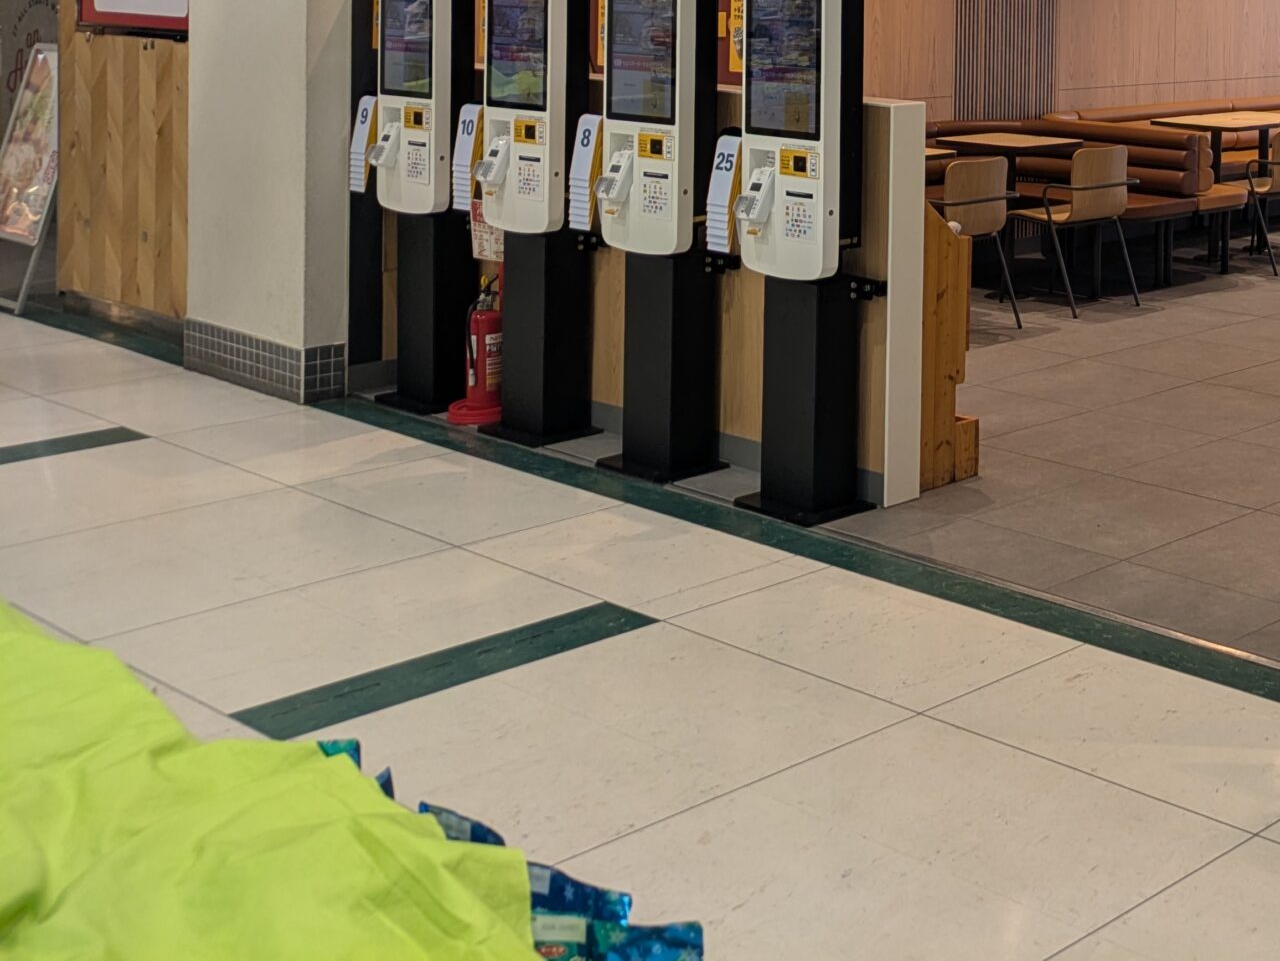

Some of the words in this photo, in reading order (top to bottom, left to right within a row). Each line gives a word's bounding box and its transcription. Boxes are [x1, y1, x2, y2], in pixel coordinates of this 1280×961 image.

[360, 108, 369, 125] 9
[461, 119, 474, 135] 10
[581, 129, 591, 147] 8
[715, 151, 734, 172] 25
